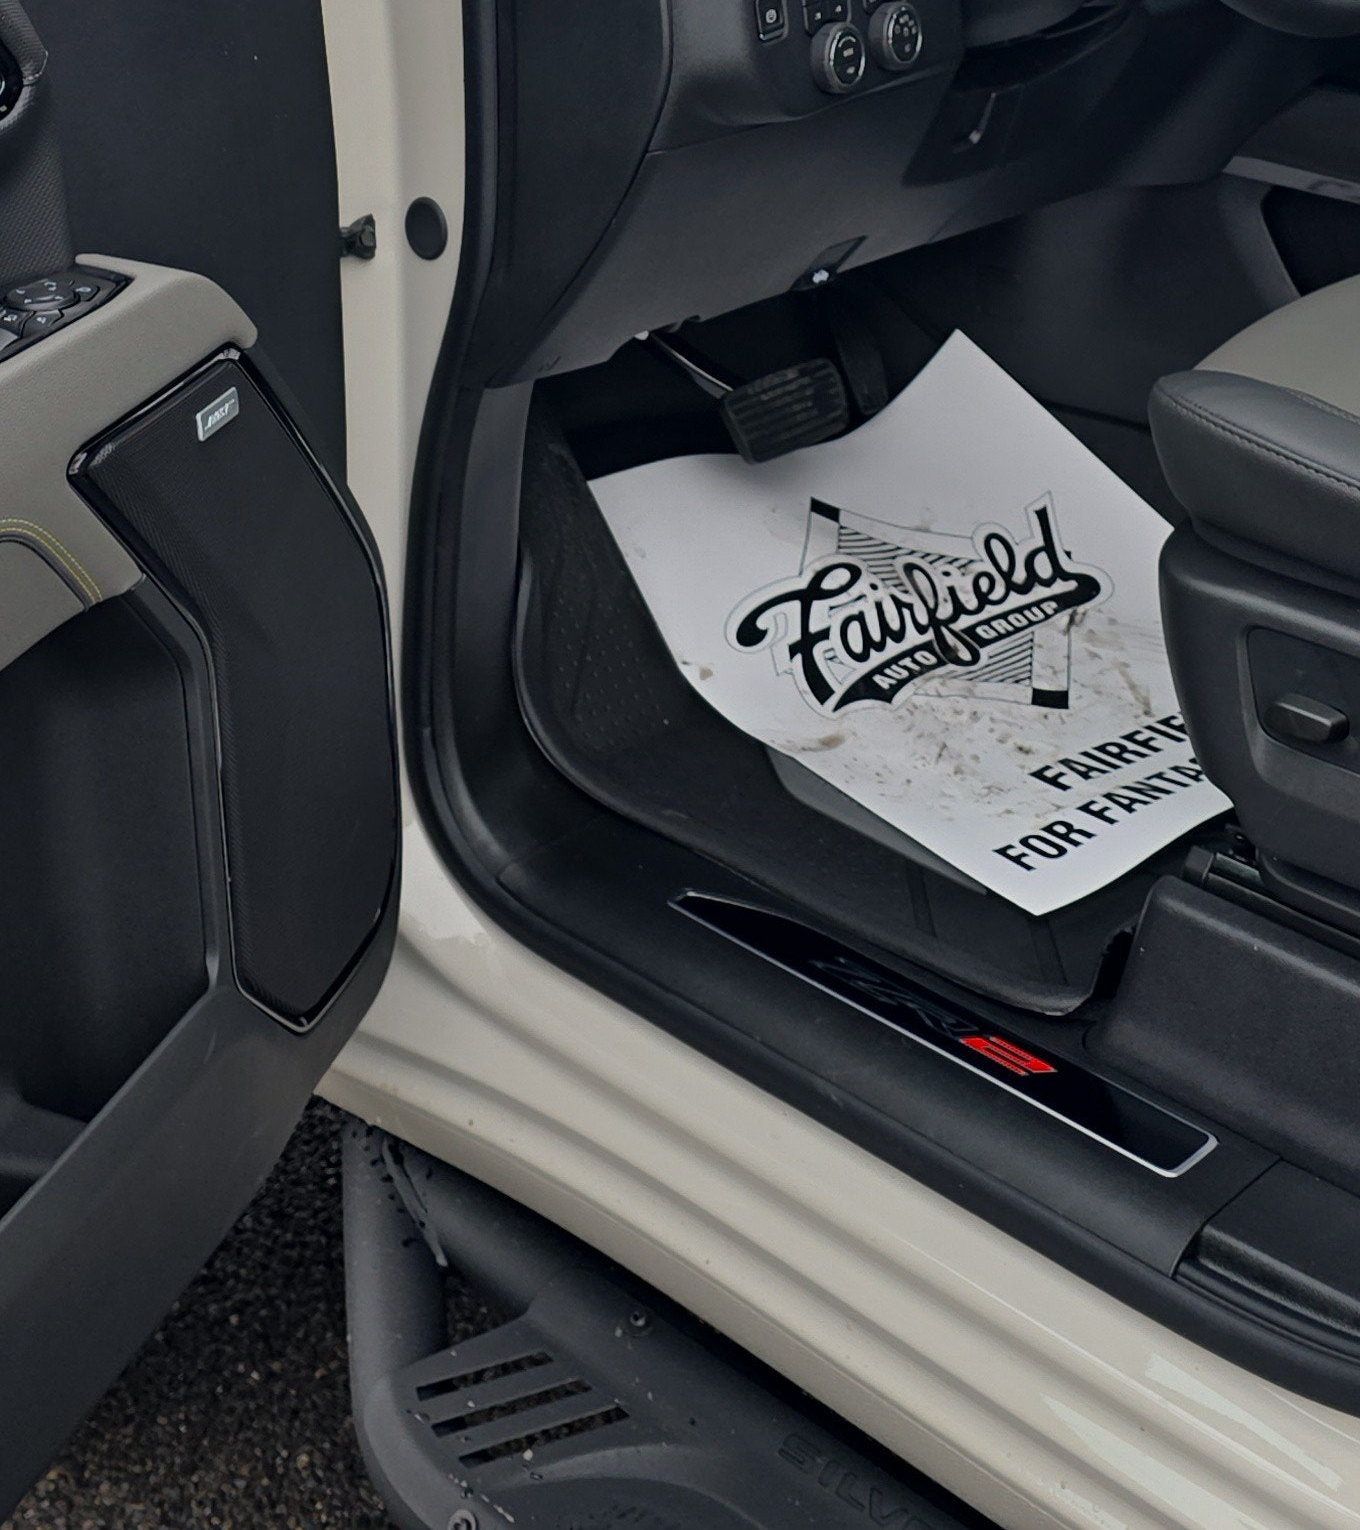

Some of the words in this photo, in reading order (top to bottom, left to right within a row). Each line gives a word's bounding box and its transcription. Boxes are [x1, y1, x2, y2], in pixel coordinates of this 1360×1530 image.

[736, 506, 1101, 706] Fairfield
[872, 650, 938, 691] AUTO
[975, 600, 1060, 640] GROUP
[992, 820, 1098, 872] FOR
[1076, 757, 1205, 826] FANTA
